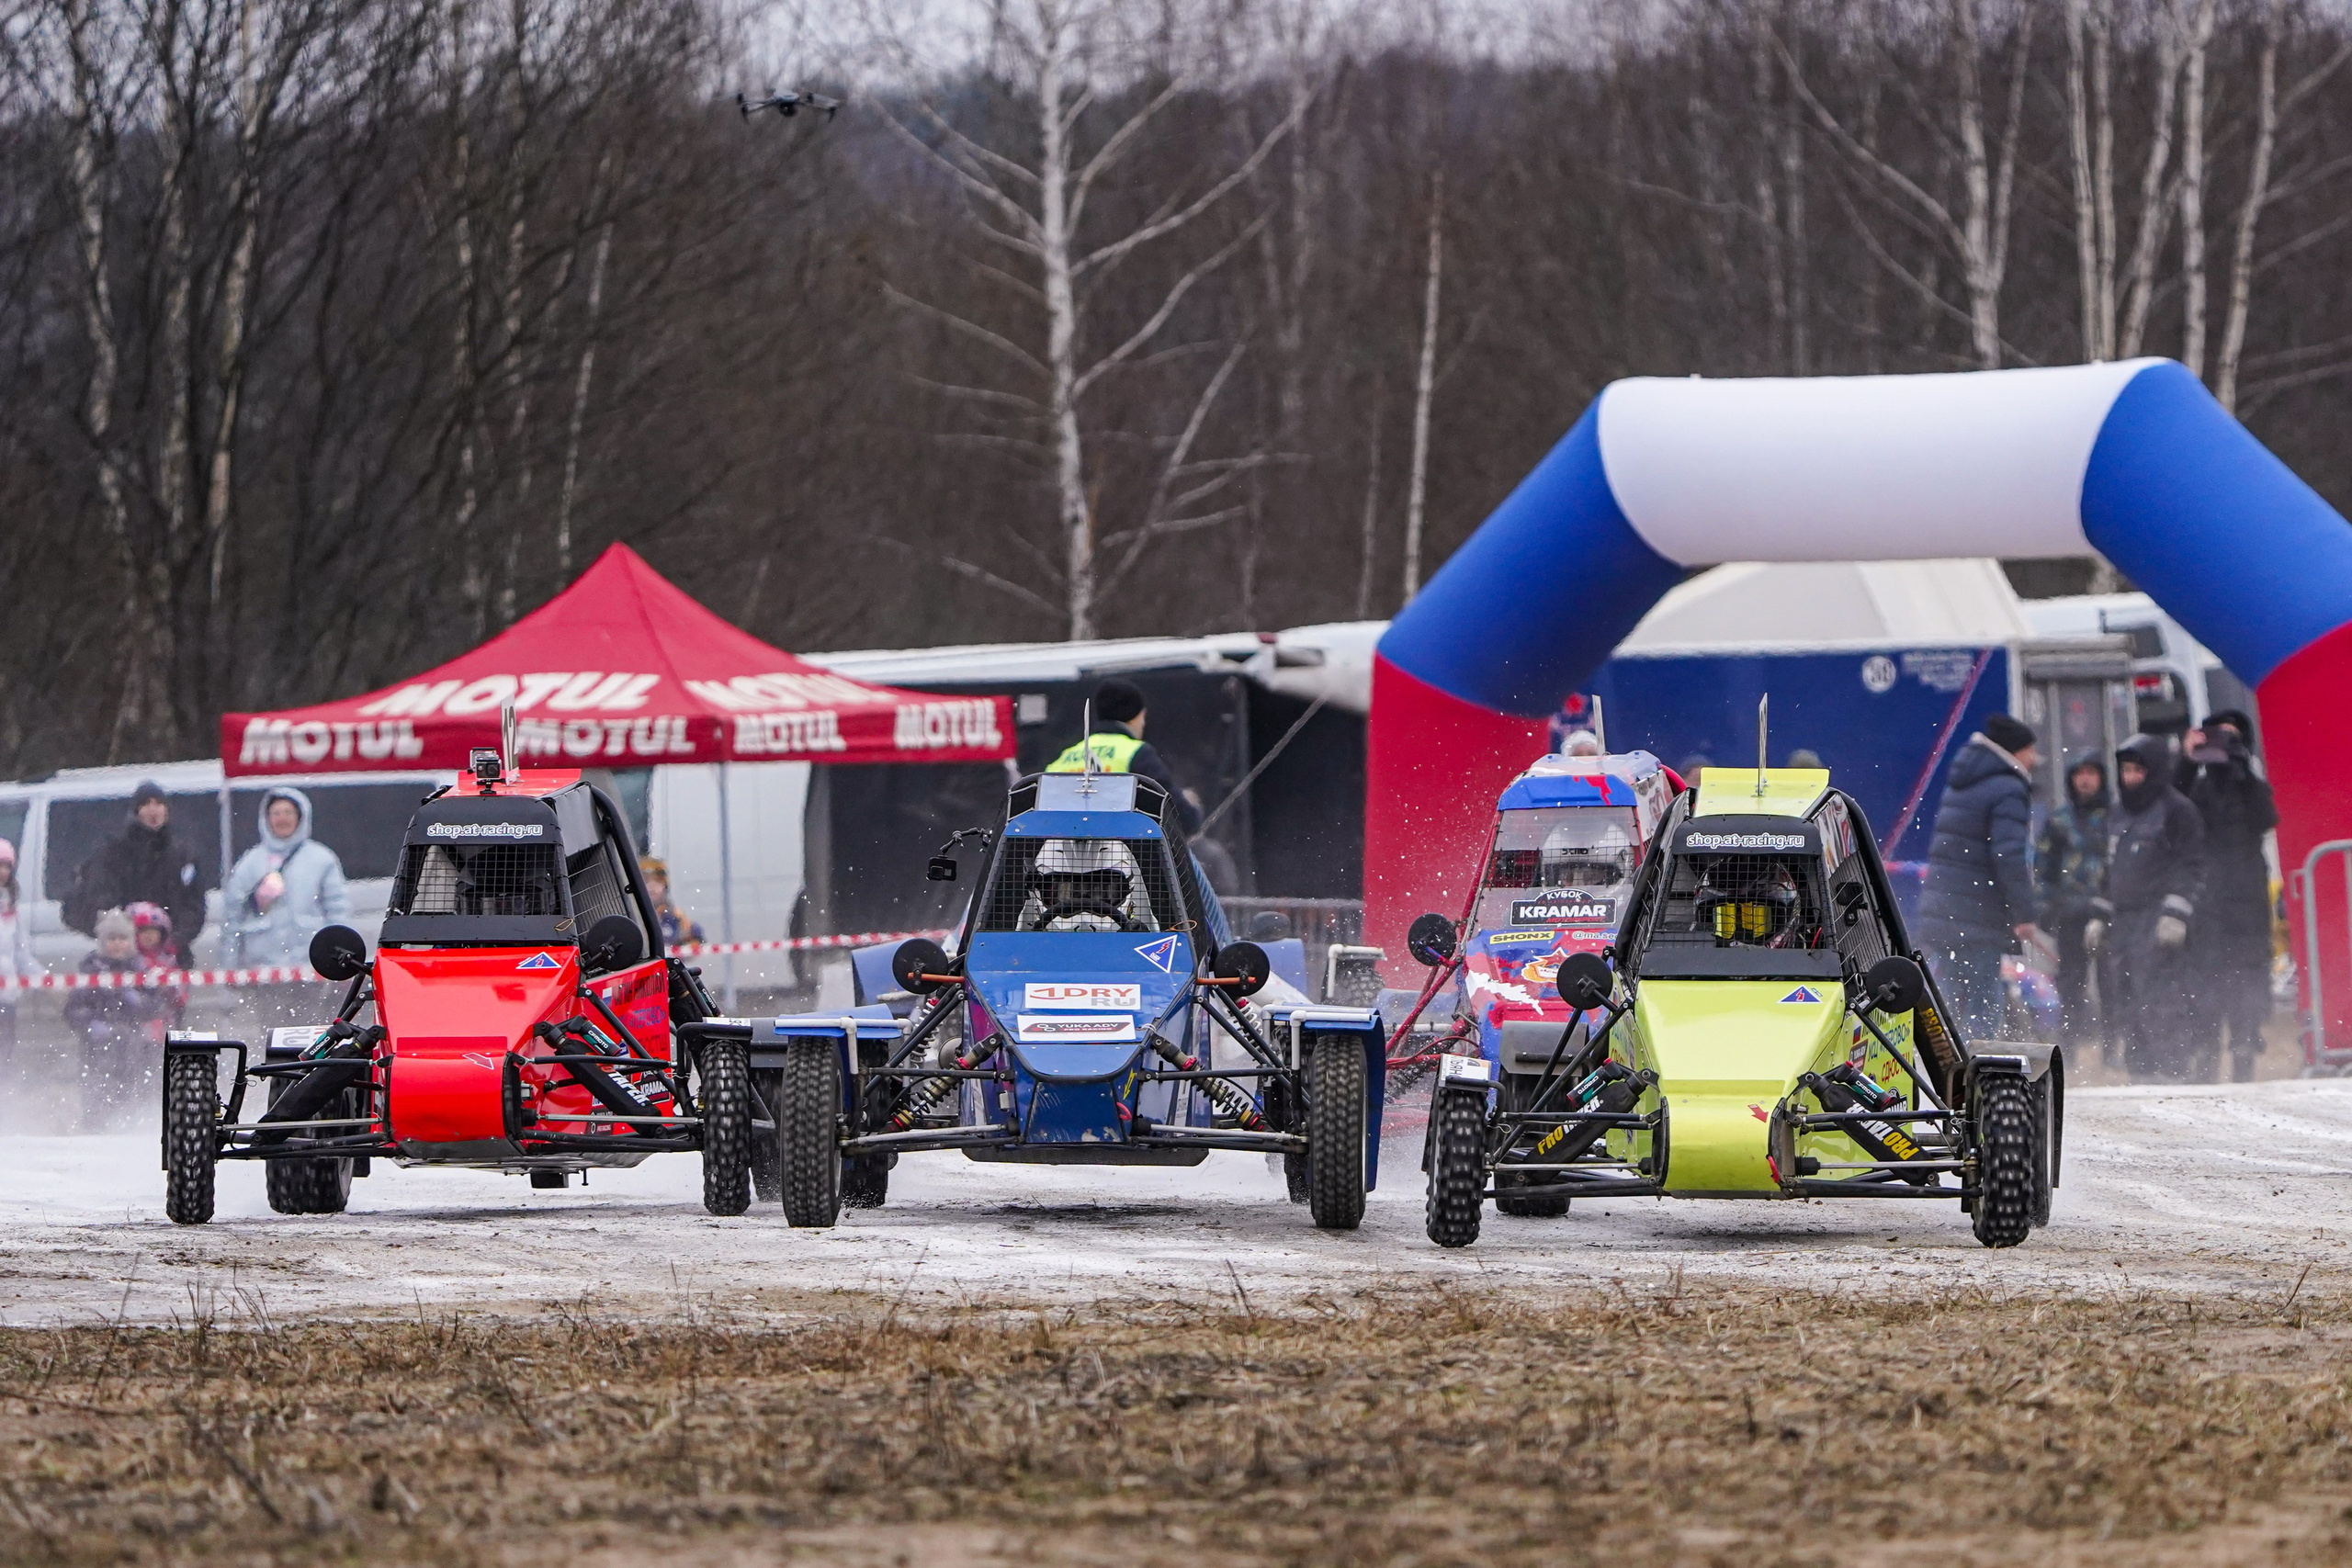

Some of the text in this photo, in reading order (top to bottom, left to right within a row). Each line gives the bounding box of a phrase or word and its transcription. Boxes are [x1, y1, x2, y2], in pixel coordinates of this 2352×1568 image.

[357, 671, 661, 716] MOTUL
[733, 710, 846, 753] MOTUL
[895, 699, 1002, 749] MOTUL
[239, 717, 424, 764] MOTUL
[503, 705, 519, 771] 12
[517, 716, 695, 757] MOTUL
[427, 822, 543, 840] shop.at-racing.ru
[1686, 832, 1804, 850] shop.at-racing.ru
[1546, 890, 1583, 900] КУБОК
[1520, 905, 1606, 918] KRAMAR
[1493, 932, 1551, 942] SHONX
[701, 988, 717, 1009] CFMOTO
[1091, 998, 1136, 1007] RU
[309, 1035, 331, 1055] CFMOTO
[588, 1030, 609, 1049] CFMOTO
[1577, 1075, 1600, 1095] CFMOTO
[1855, 1080, 1878, 1100] CFMOTO
